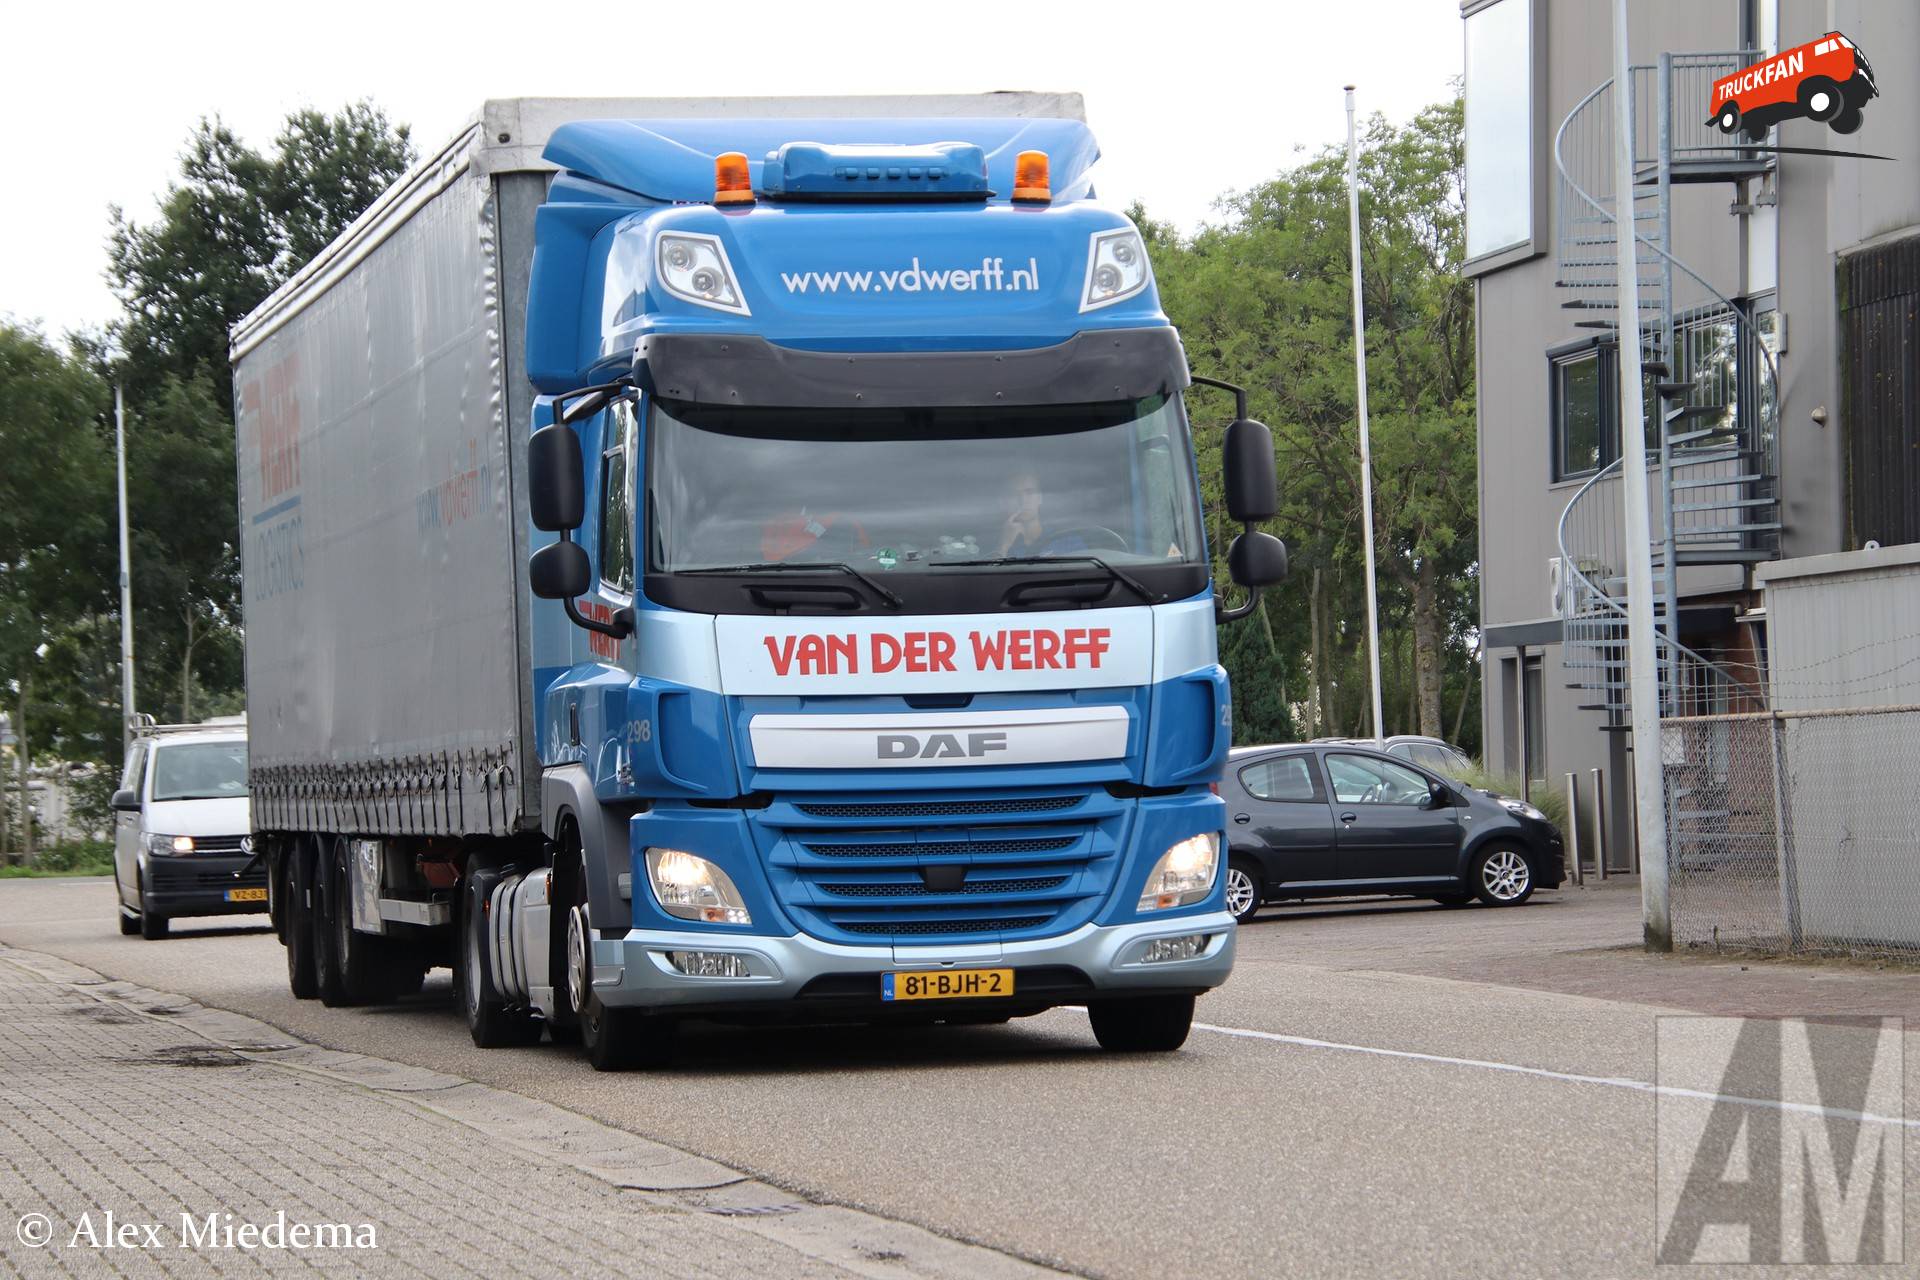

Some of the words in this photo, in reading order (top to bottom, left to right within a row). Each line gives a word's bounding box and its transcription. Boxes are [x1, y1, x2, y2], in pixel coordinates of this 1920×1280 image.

[780, 257, 1040, 293] www.vdwerff.nl
[763, 635, 858, 676] VAN
[870, 632, 958, 674] DER
[968, 628, 1111, 671] WERFF
[877, 732, 1007, 760] DAF
[905, 973, 1002, 996] 81-BJH-2
